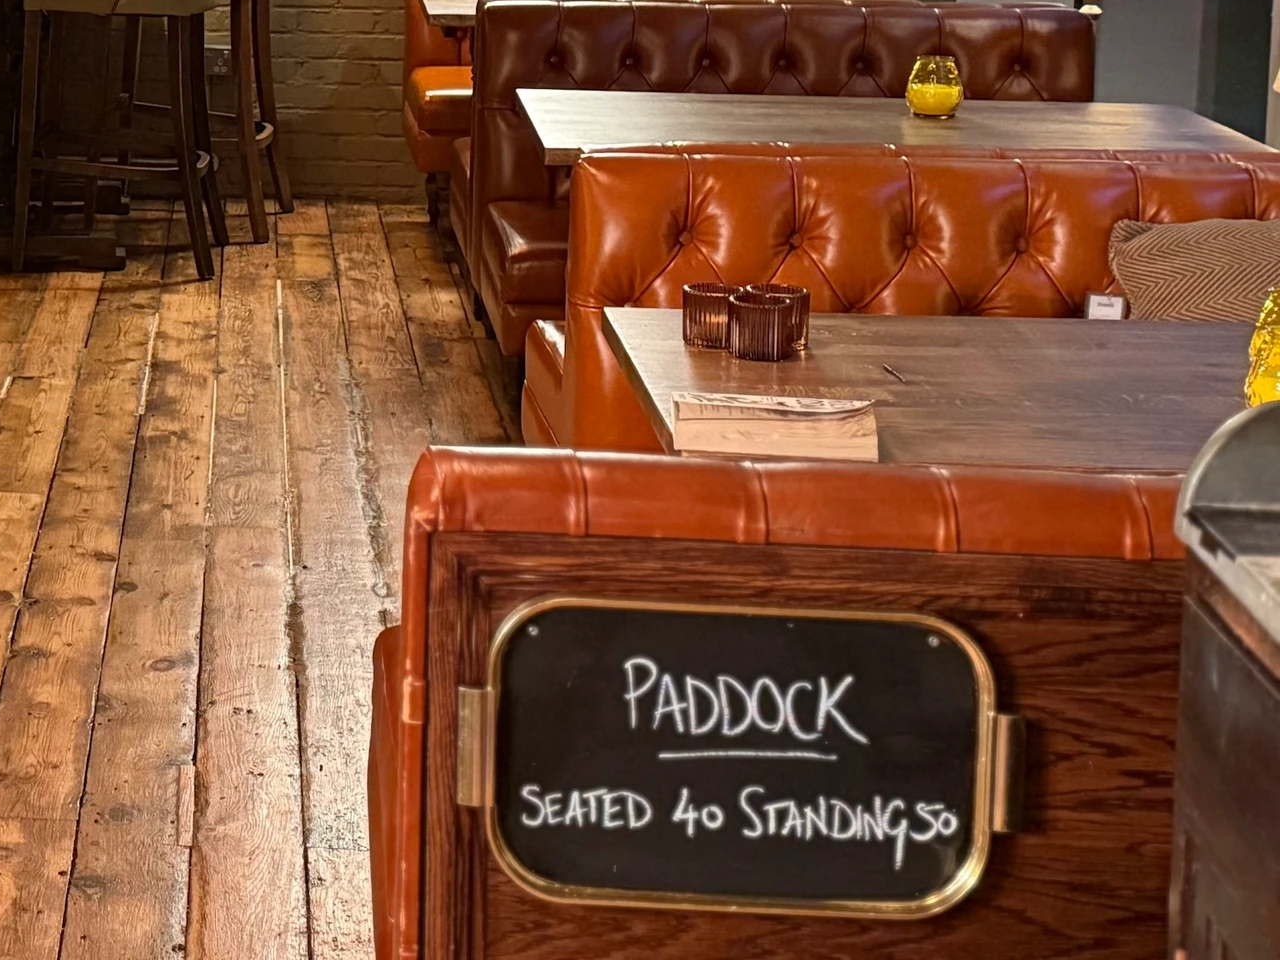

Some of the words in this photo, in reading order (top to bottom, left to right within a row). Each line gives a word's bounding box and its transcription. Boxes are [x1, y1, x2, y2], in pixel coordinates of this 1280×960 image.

[624, 656, 870, 744] PADDOCK
[521, 784, 653, 829] SEATED
[672, 787, 724, 838] 40
[739, 785, 908, 870] STANDING
[909, 802, 959, 842] 50
